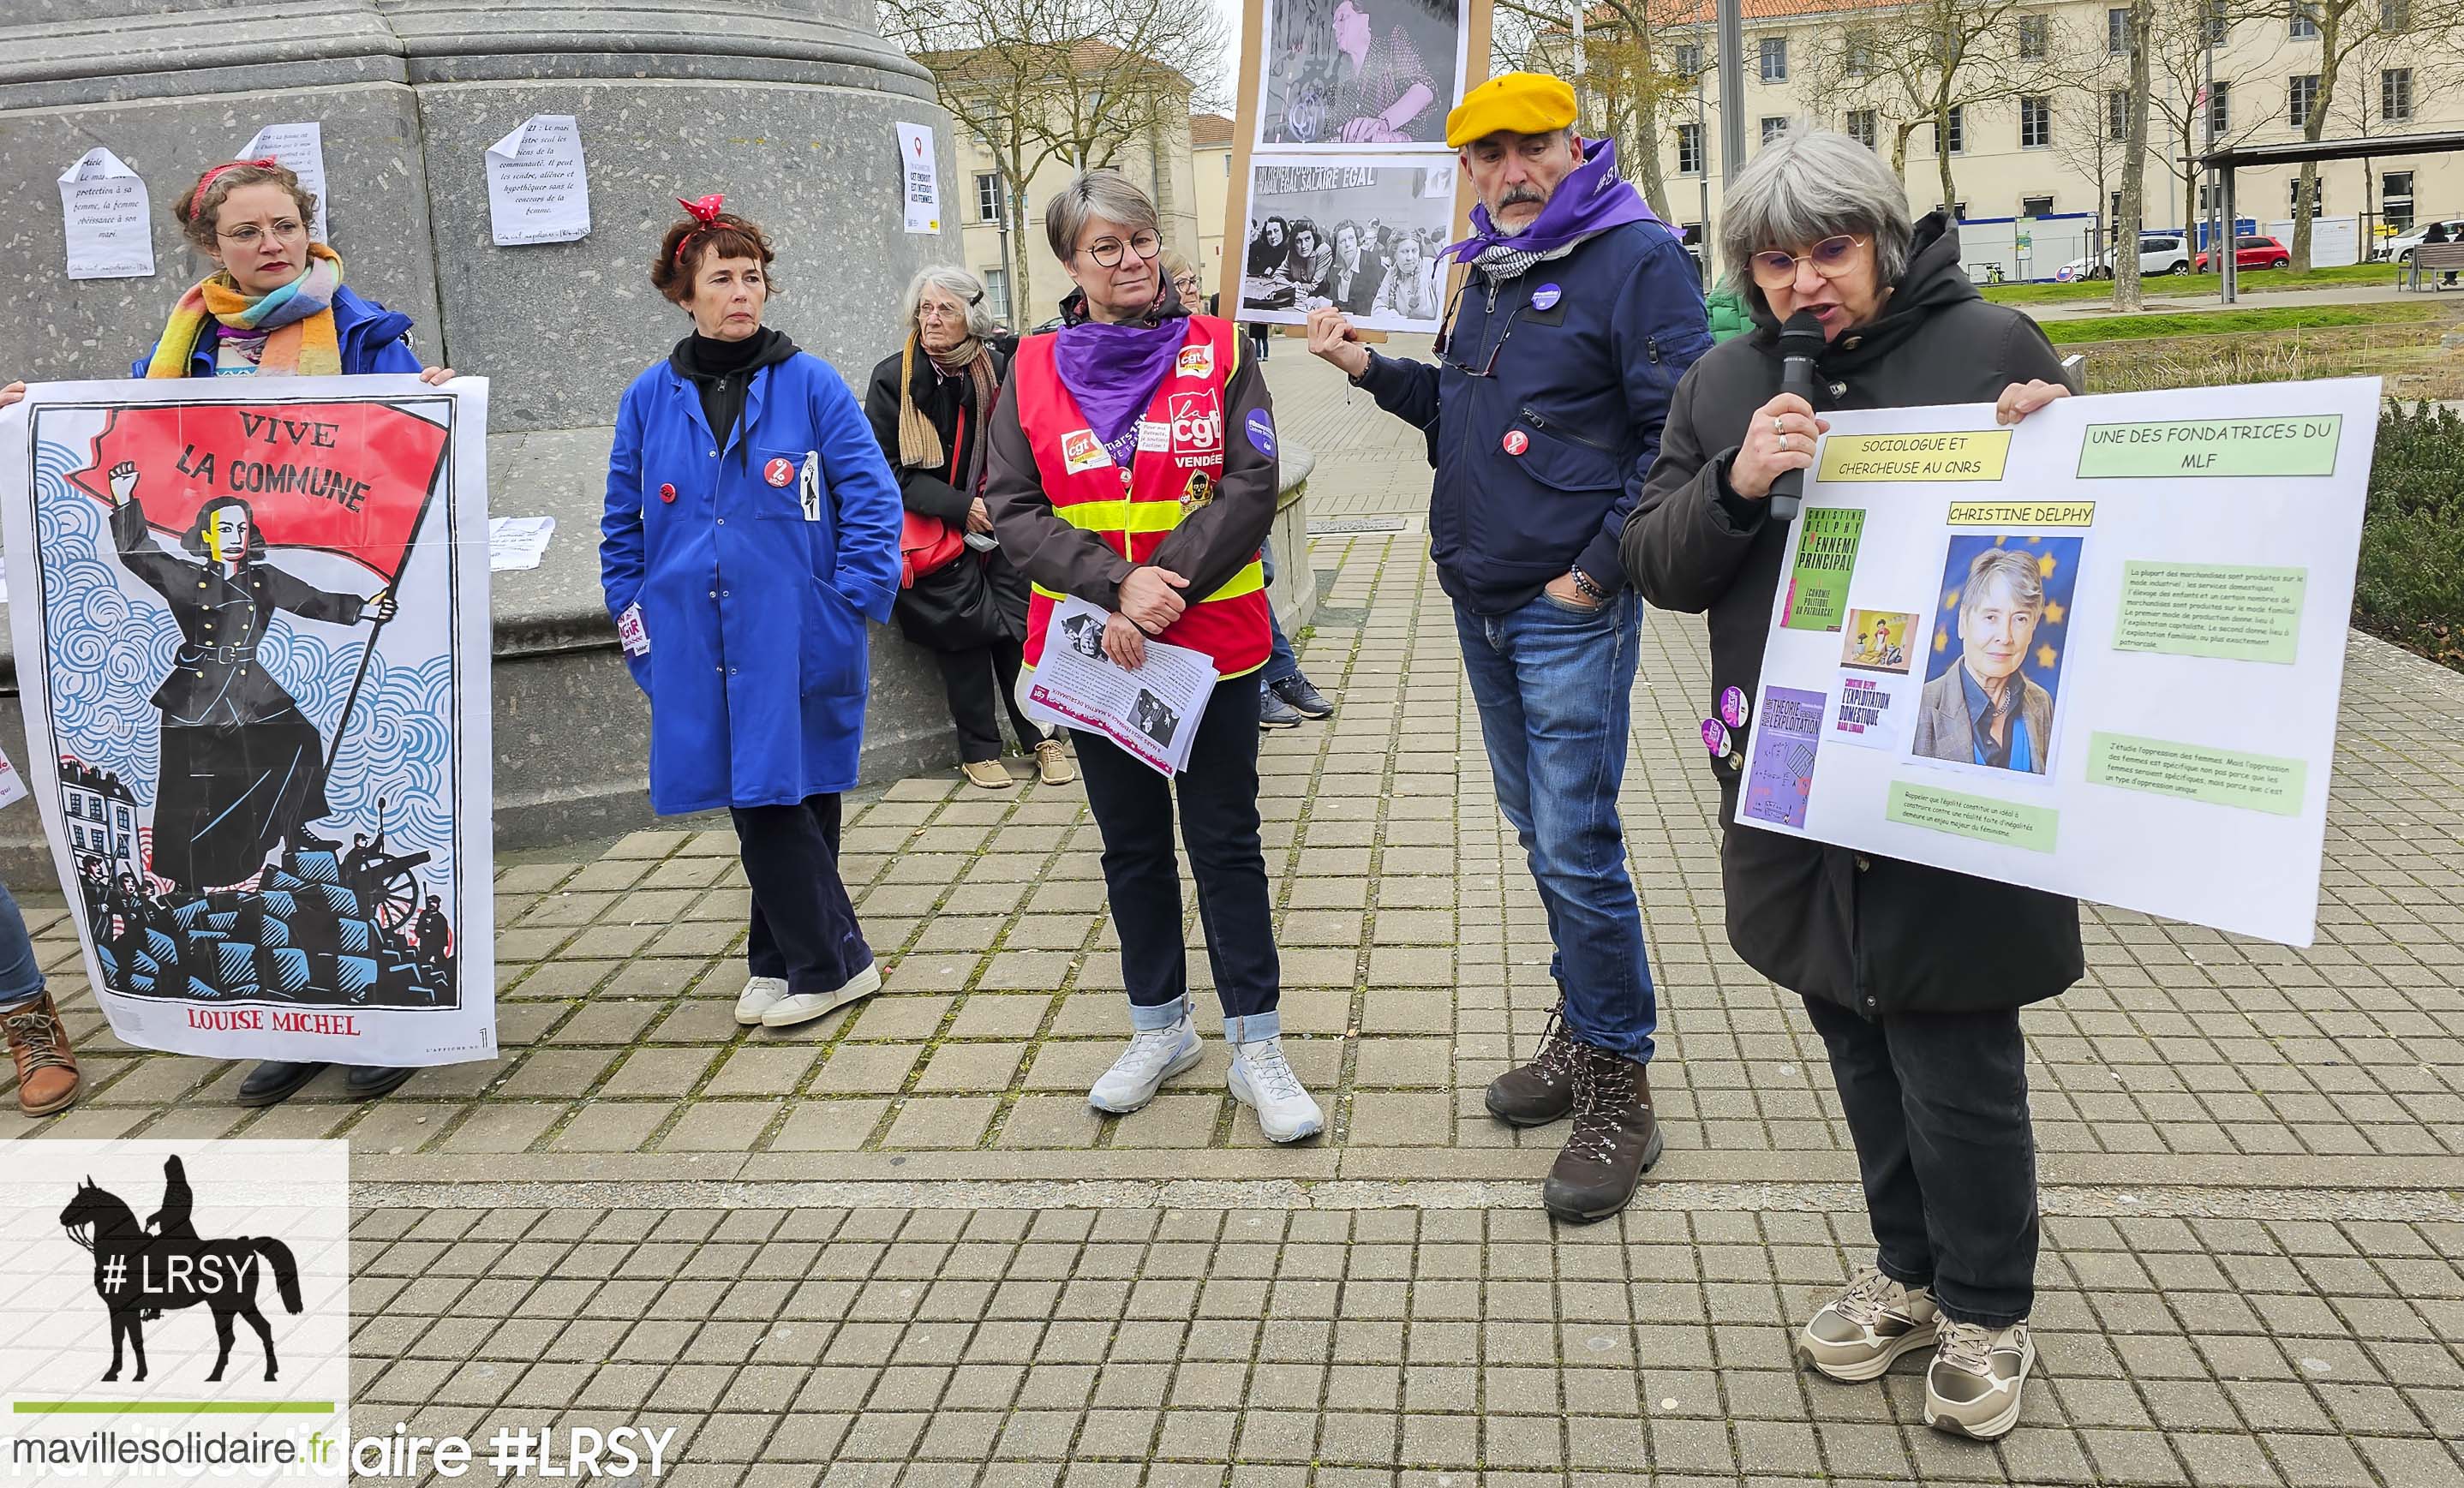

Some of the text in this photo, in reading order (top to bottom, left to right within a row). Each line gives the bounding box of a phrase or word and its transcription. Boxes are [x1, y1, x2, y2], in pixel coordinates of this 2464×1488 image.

[1280, 177, 1297, 194] EGAL
[1301, 168, 1339, 191] SALAIRE
[1343, 166, 1373, 187] EGAL
[76, 188, 113, 198] protection
[74, 201, 100, 212] femme,
[113, 200, 139, 210] femme
[526, 206, 552, 216] femme.
[78, 215, 115, 224] obéissance
[117, 215, 122, 224] à
[99, 230, 117, 238] mari.
[1181, 352, 1201, 363] cgt
[1175, 400, 1211, 421] la
[239, 411, 339, 448] VIVE
[1174, 409, 1221, 448] cgt
[2092, 422, 2331, 444] UNE DES FONDATRICES DU
[1069, 439, 1089, 456] cgt
[1861, 437, 1969, 452] SOCIOLOGUE ET
[1175, 453, 1223, 469] VENDÉE
[1839, 461, 1982, 475] CHERCHEUSE AU CNRS
[2181, 453, 2217, 469] MLF
[176, 444, 371, 514] LA COMMUNE
[1809, 510, 1863, 521] CHRISTINE
[1950, 507, 2093, 522] CHRISTINE DELPHY
[1806, 521, 1860, 534] DELPHY
[1802, 532, 1856, 553] L'ENNEMI
[1797, 553, 1851, 571] PRINCIPAL
[2141, 570, 2165, 578] plupart
[2180, 571, 2226, 580] marchandises
[2246, 574, 2281, 583] produites
[2173, 590, 2199, 599] enfants
[1803, 607, 1833, 617] PATRIARCAT
[2126, 599, 2171, 607] marchandises
[2189, 602, 2222, 611] produites
[2134, 610, 2161, 619] premier
[2192, 613, 2230, 621] production
[2226, 636, 2270, 646] exactement
[1842, 688, 1891, 709] L'EXPLOITATION
[1761, 712, 1770, 726] POUR
[1839, 705, 1880, 726] DOMESTIQUE
[1769, 714, 1820, 735] L'EXPLOITATION
[2122, 755, 2148, 765] femmes
[2162, 760, 2198, 772] spécifique
[2228, 769, 2250, 780] parce
[2138, 747, 2290, 774] l'oppression des Mais l'oppression
[2107, 763, 2247, 791] femmes seraient mais parce
[2115, 774, 2130, 785] type
[1905, 791, 1929, 803] Rappeler
[1963, 802, 1989, 813] constitue
[2000, 808, 2014, 817] idéal
[1902, 810, 1971, 830] demeure enjeu majeur
[1904, 802, 1931, 812] construire
[1933, 806, 1951, 816] contre
[1963, 811, 1983, 822] réalité
[1983, 816, 1998, 825] faite
[187, 1008, 361, 1036] LOUISE MICHEL
